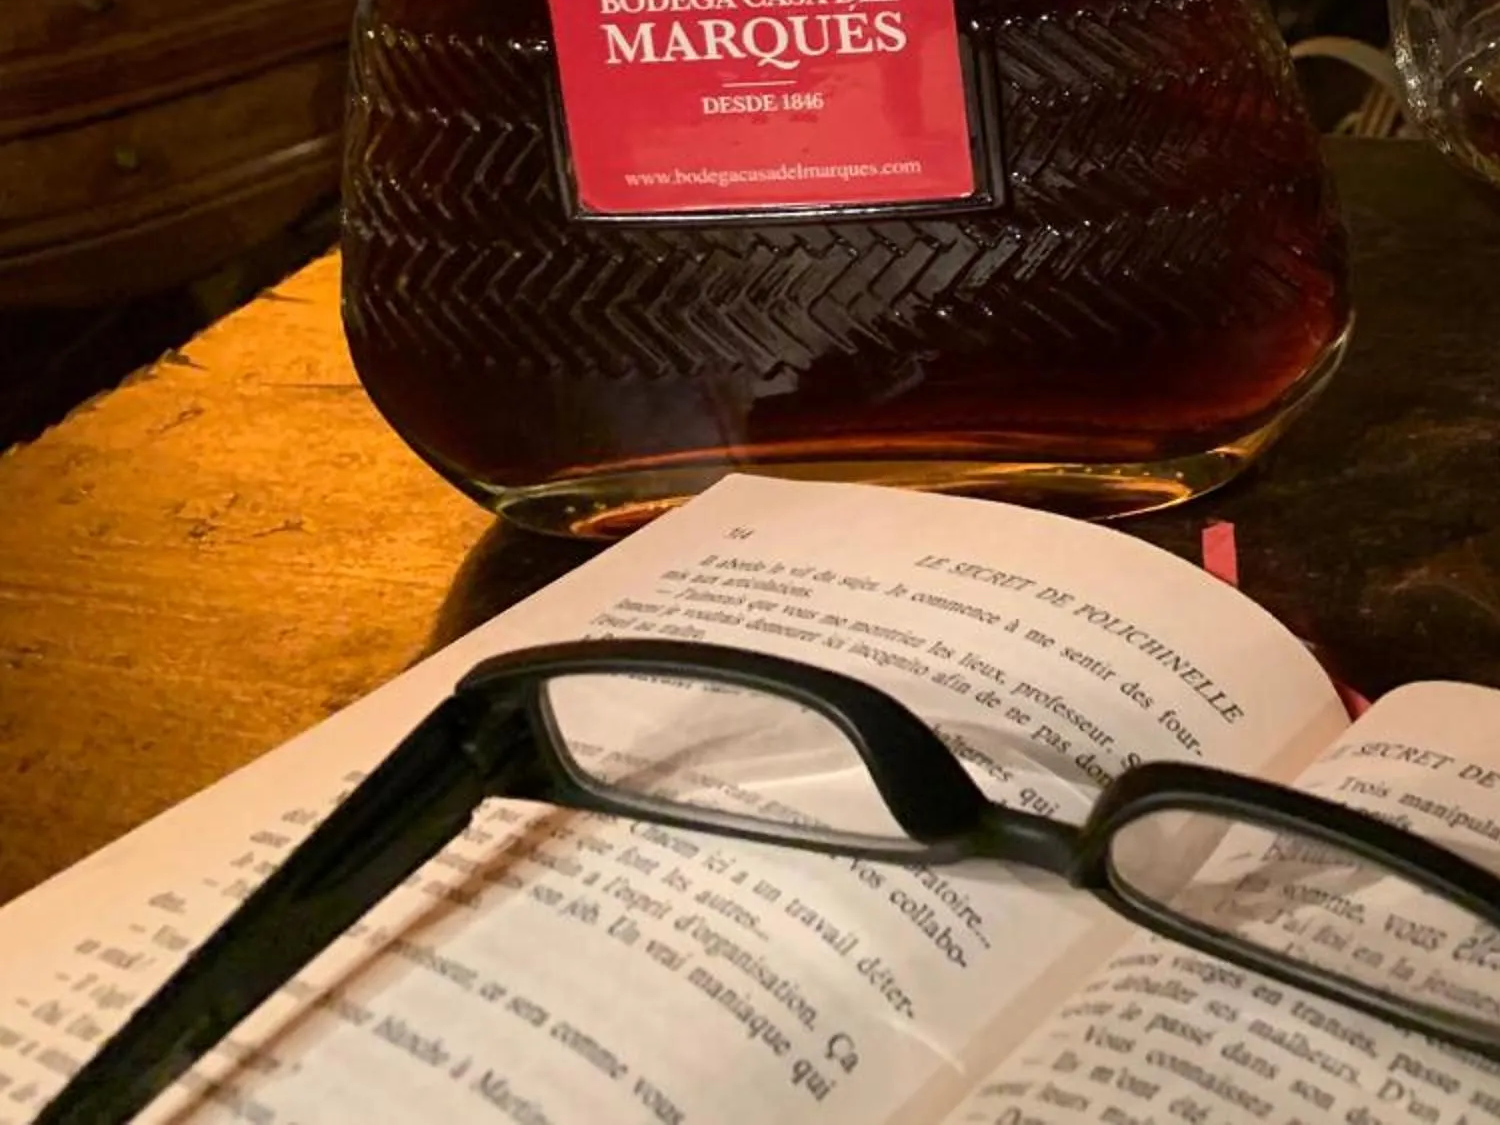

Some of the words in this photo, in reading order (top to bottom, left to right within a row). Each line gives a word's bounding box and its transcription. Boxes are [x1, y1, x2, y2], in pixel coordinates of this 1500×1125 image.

[603, 4, 907, 69] MARQUÉS
[702, 95, 778, 115] DESDE
[781, 93, 825, 112] 1846
[624, 158, 922, 188] www.bodegacasadelmarques.com
[911, 588, 1002, 626] commence
[1004, 615, 1020, 633] à
[1025, 627, 1057, 649] me
[1060, 643, 1117, 683] sentir
[1120, 679, 1157, 712] des
[1157, 707, 1205, 757] four-
[914, 554, 945, 570] LE
[949, 561, 1038, 592] SECRET
[1036, 586, 1074, 607] DE
[1073, 602, 1247, 725] POLICHINELLE
[928, 639, 955, 661] les
[1010, 679, 1115, 754] professeur.
[931, 671, 973, 695] afin
[974, 689, 1003, 709] de
[1004, 706, 1032, 726] ne
[1031, 724, 1073, 755] pas
[1074, 753, 1115, 791] don
[1338, 775, 1392, 799] Trois
[1018, 785, 1059, 818] qui
[785, 897, 860, 958] travail
[857, 954, 917, 1020] déter-
[889, 888, 967, 969] collabo-
[674, 912, 818, 1032] d'organisation.
[824, 1031, 861, 1074] Ça
[687, 964, 793, 1058] maniaque
[792, 1054, 837, 1102] qui
